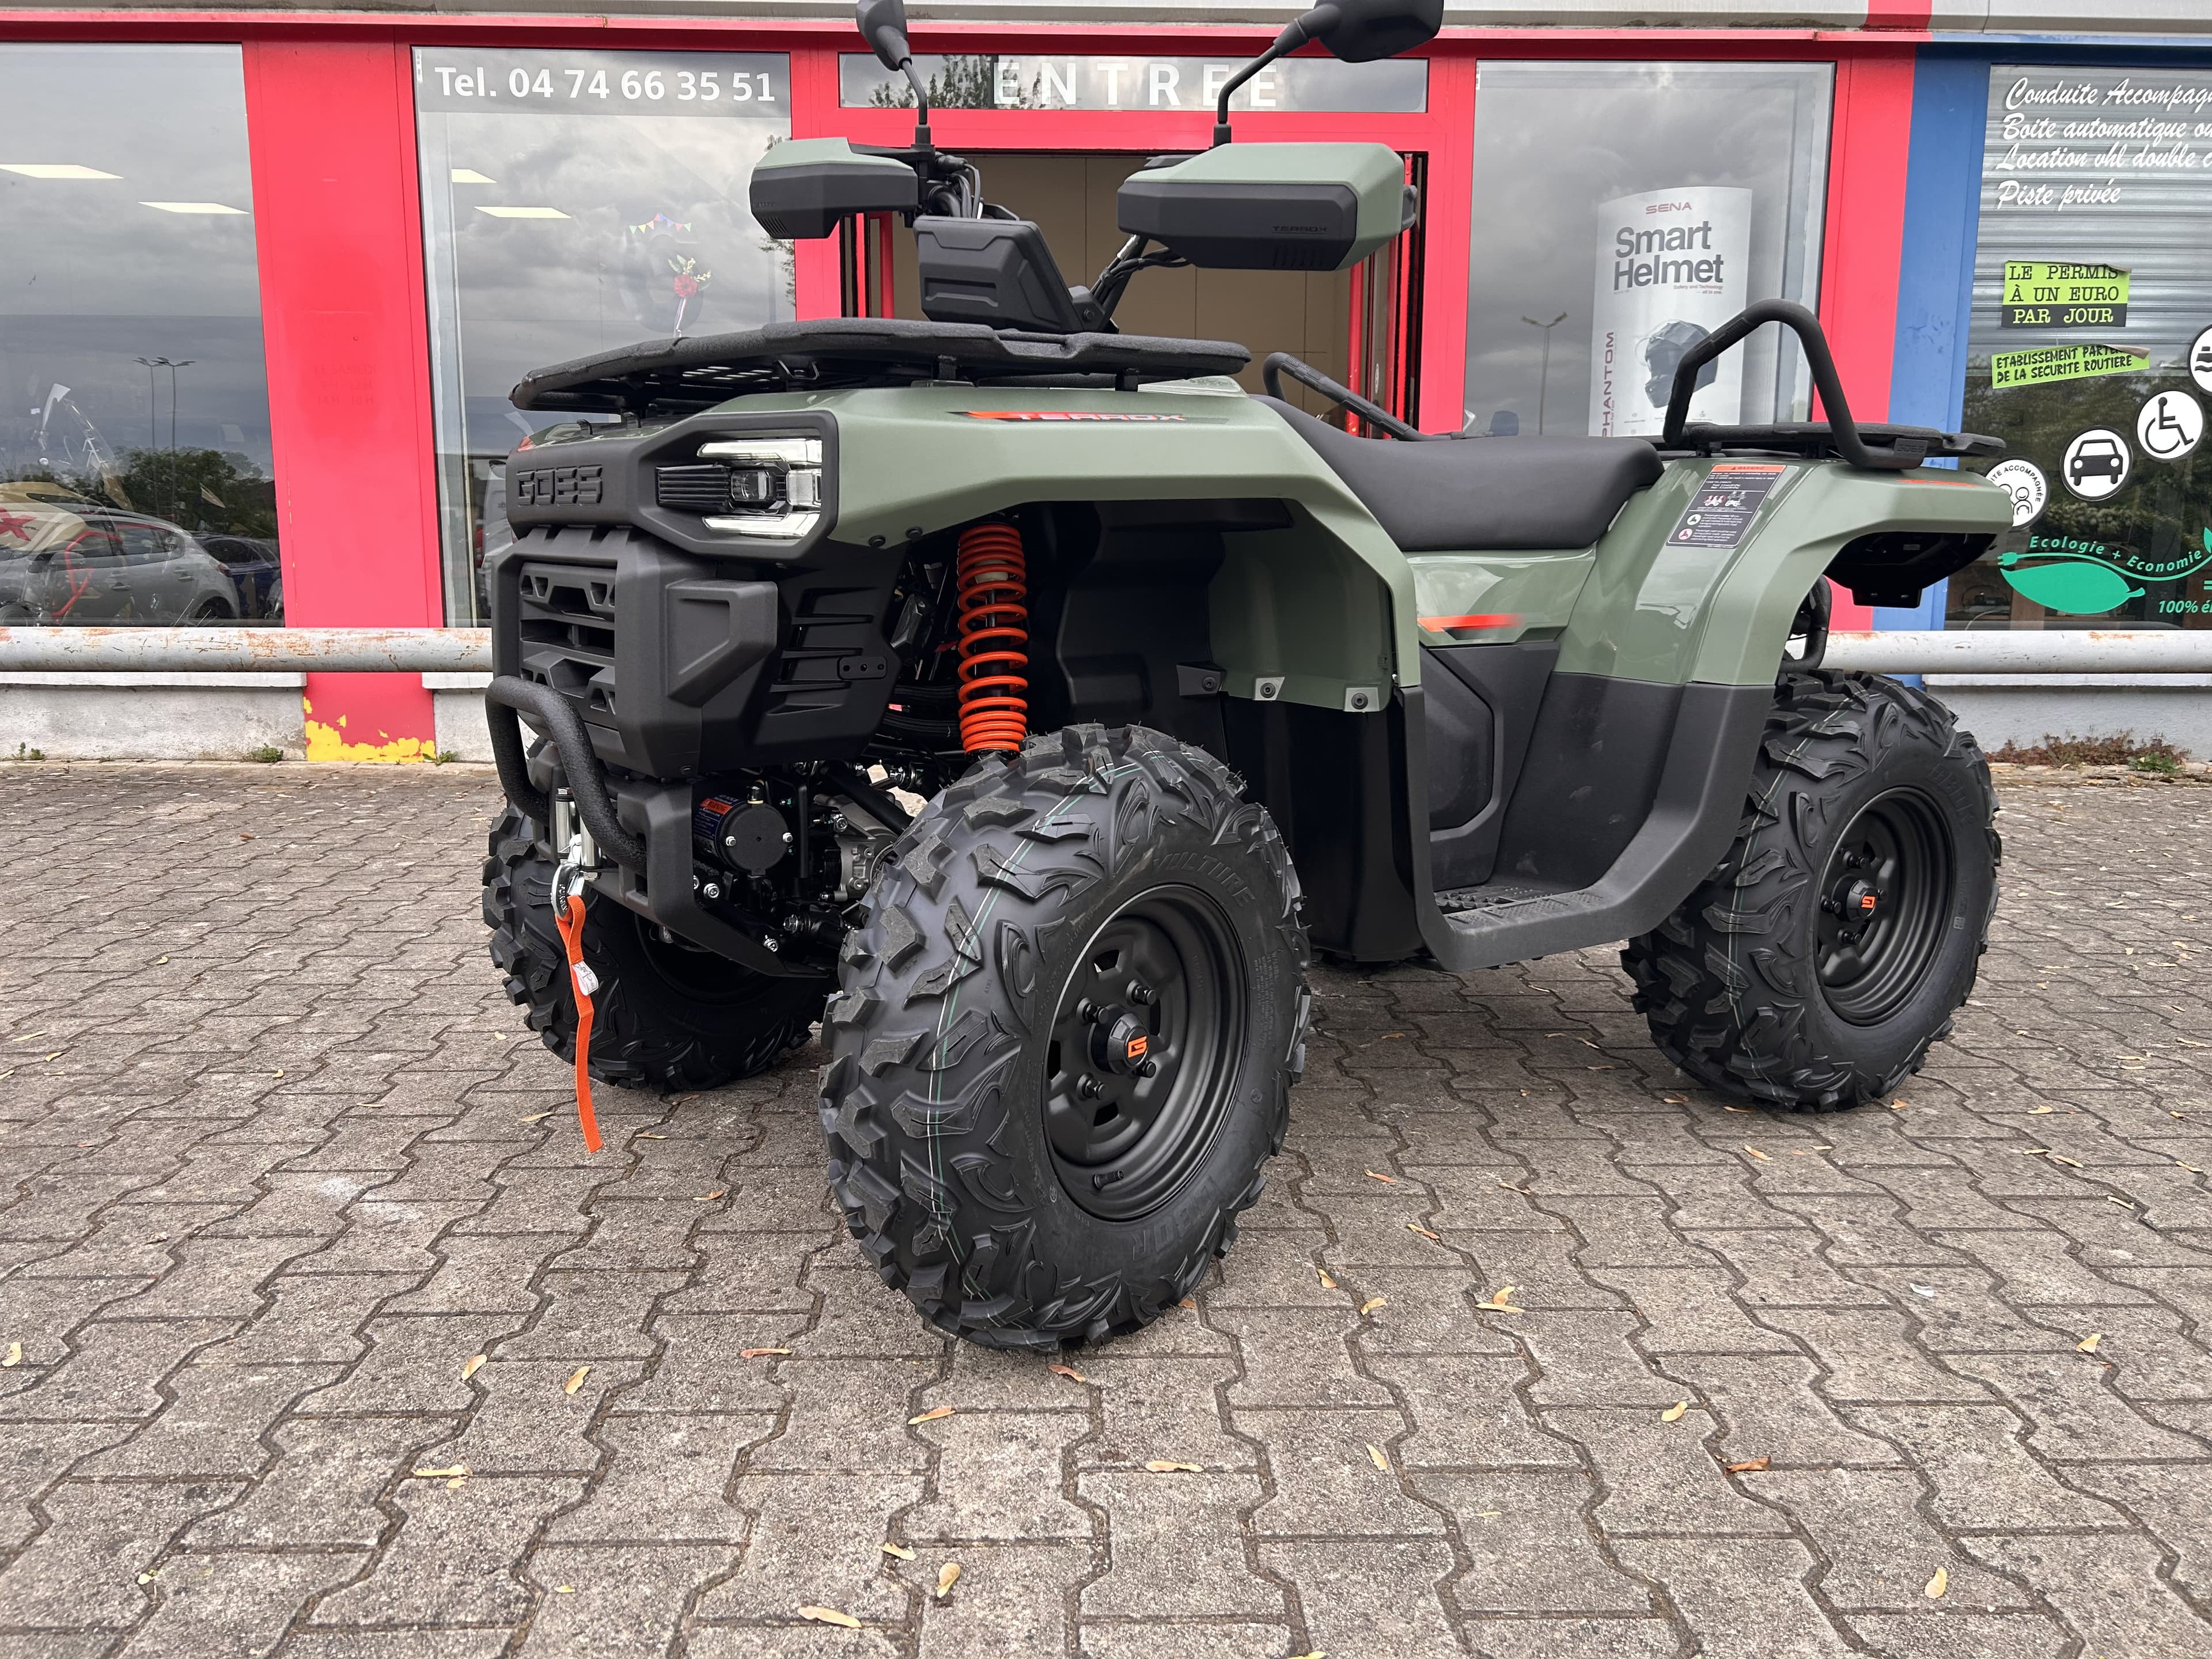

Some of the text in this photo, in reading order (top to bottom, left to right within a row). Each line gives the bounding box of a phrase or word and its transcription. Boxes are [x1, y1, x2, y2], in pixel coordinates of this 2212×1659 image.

[434, 67, 497, 97] Tel.
[509, 68, 554, 97] 04
[565, 70, 609, 99] 74
[620, 70, 665, 100] 66
[678, 71, 720, 101] 35
[733, 72, 775, 102] 51
[993, 62, 1277, 107] ENTREE
[2006, 77, 2097, 110] Conduite
[2003, 112, 2057, 140] Boite
[2063, 116, 2187, 146] automatique
[1995, 143, 2088, 170] Location
[2094, 141, 2126, 168] vhl
[2133, 141, 2196, 168] double
[1646, 202, 1692, 214] SENA
[1997, 178, 2121, 211] Piste privée
[1615, 221, 1711, 258] Smart
[1613, 254, 1724, 291] Helmet
[2009, 266, 2119, 281] LE PERMIS
[2009, 285, 2119, 302] À UN EURO
[2013, 308, 2113, 324] PAR JOUR
[1997, 347, 2078, 369] ETABLISSEMENT
[1997, 354, 2132, 384] DE LA SECURITE ROUTIERE
[1602, 332, 1614, 437] PHANTOM
[516, 464, 603, 507] GOES
[2004, 465, 2043, 502] ACCOMPAGNÉE
[2029, 536, 2105, 555] Ecologie
[2126, 550, 2202, 573] Economie
[2159, 600, 2198, 613] 100%
